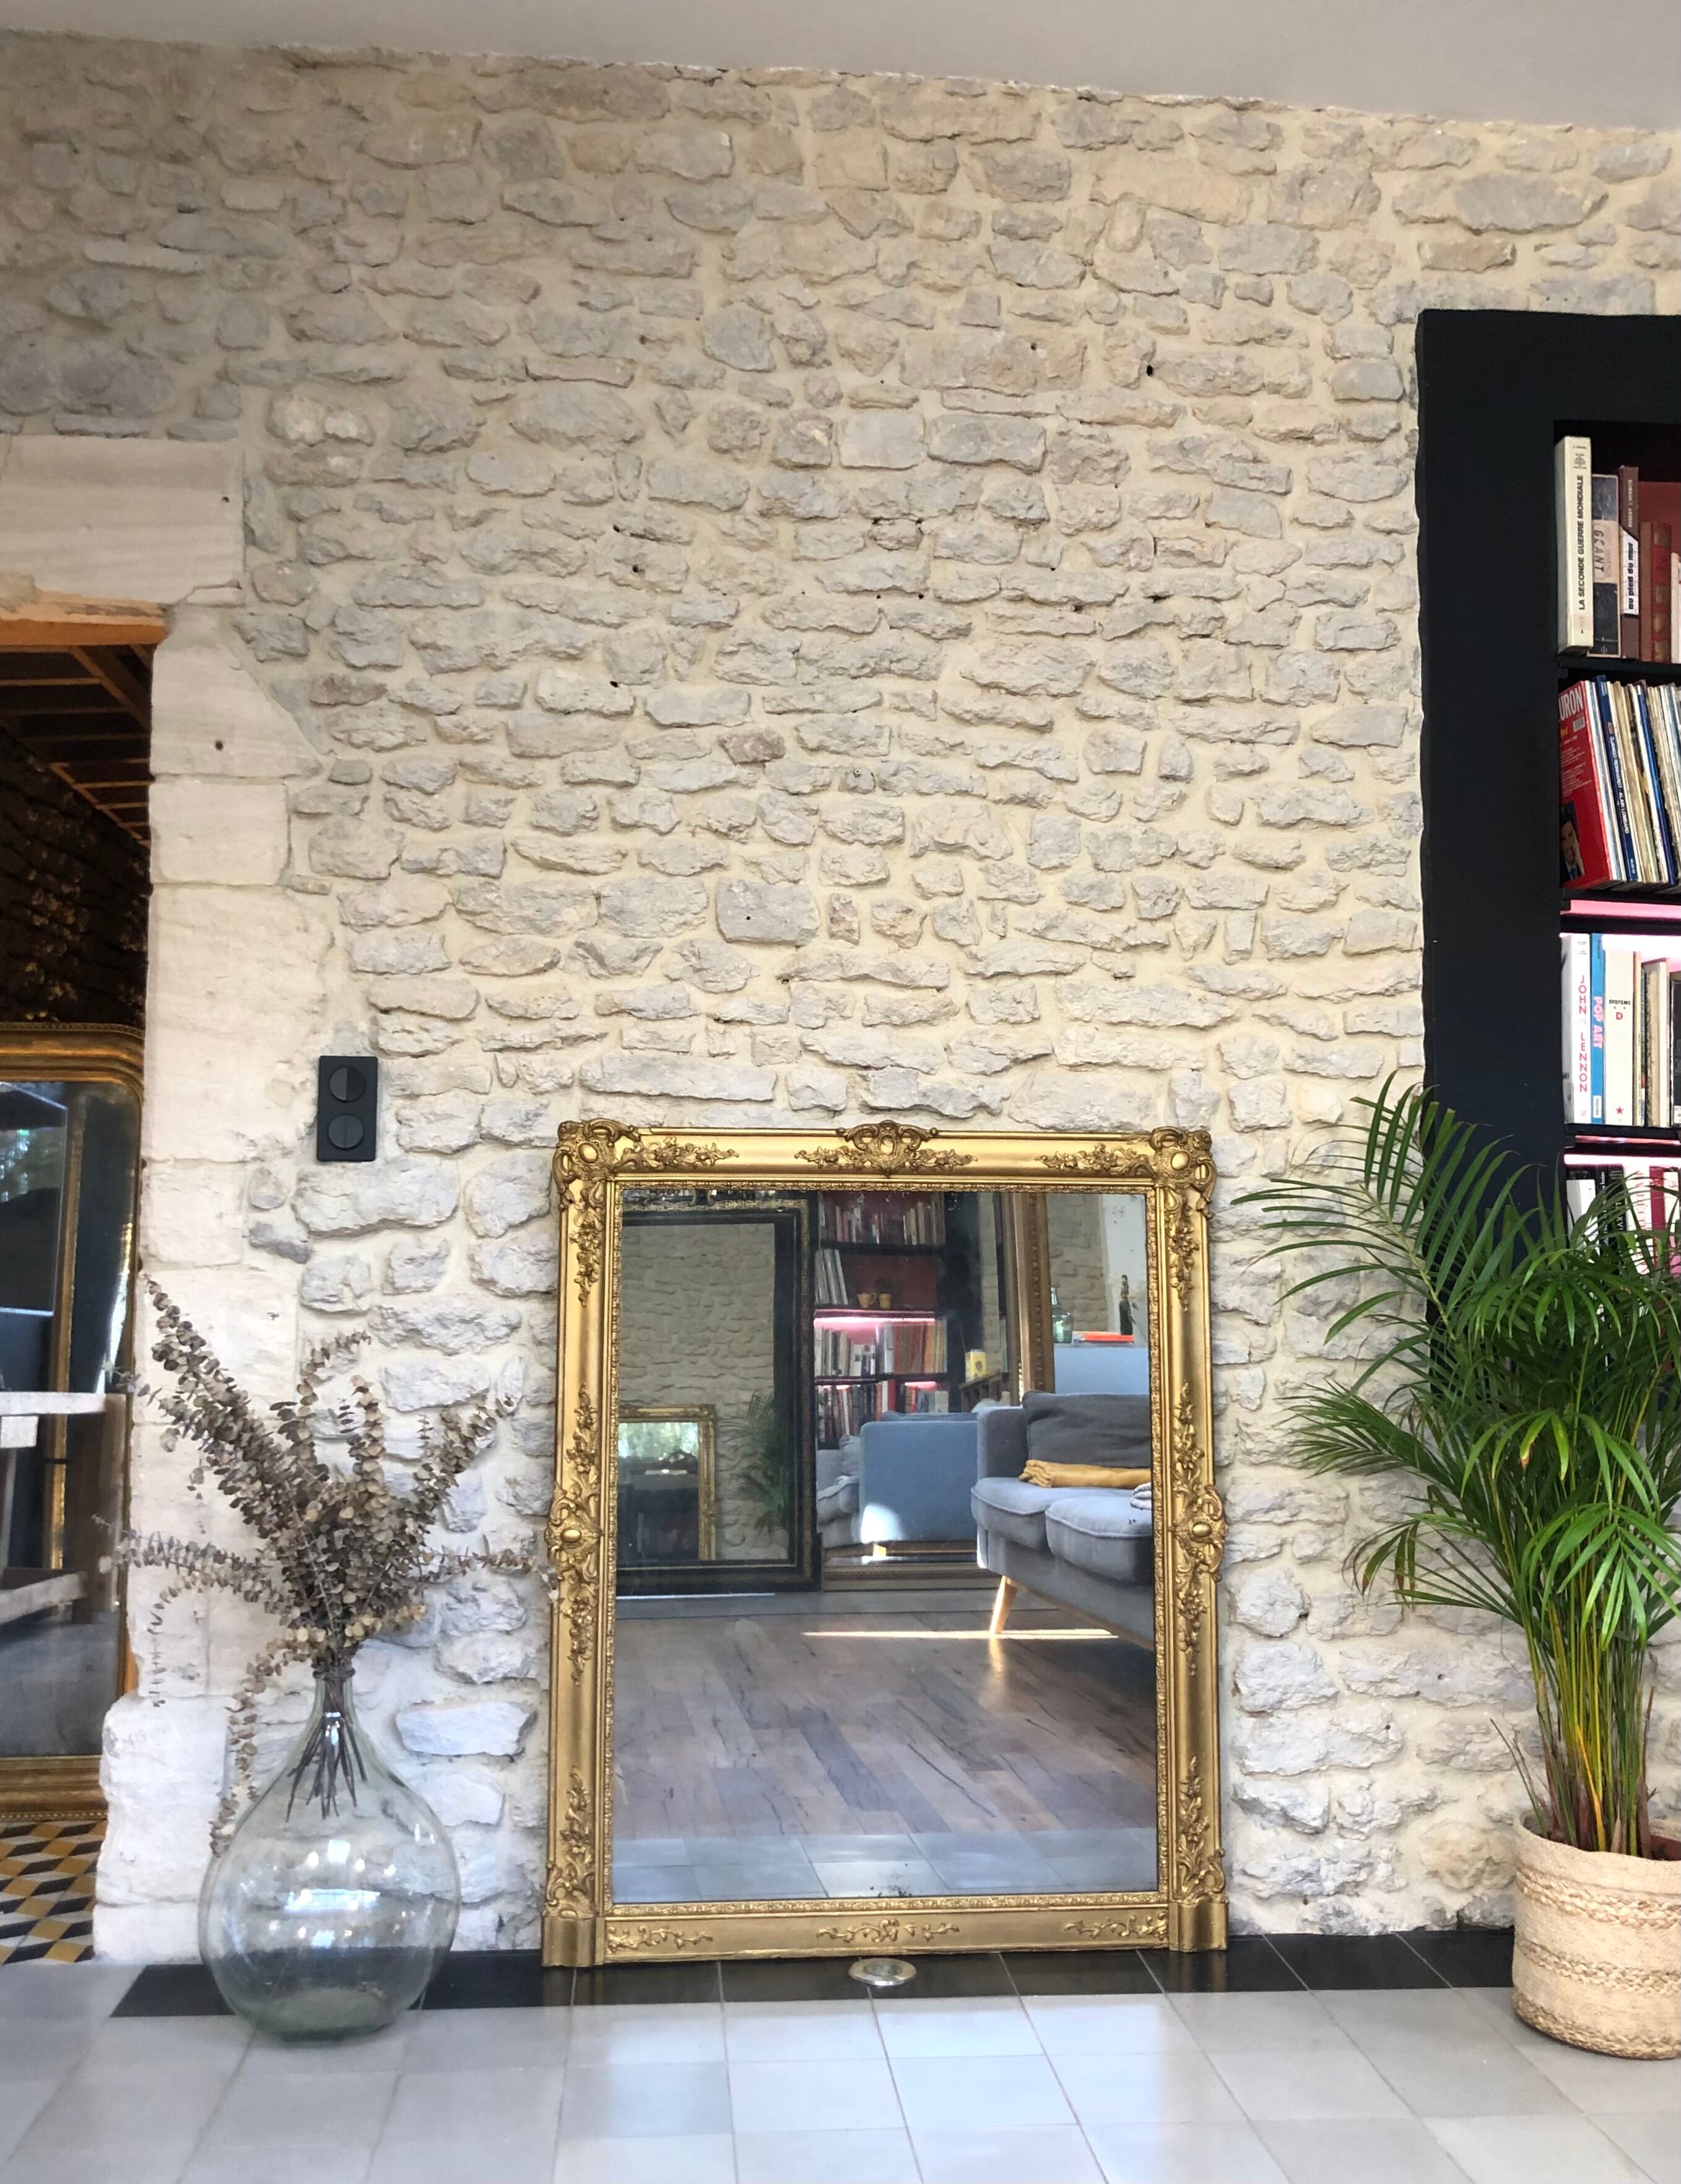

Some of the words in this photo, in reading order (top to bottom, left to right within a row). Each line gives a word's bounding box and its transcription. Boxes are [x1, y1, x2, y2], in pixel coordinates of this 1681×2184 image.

[1627, 563, 1634, 574] du
[1579, 599, 1585, 610] LA
[1558, 685, 1583, 721] URON
[1578, 975, 1587, 1014] JOHN
[1594, 996, 1604, 1022] POP
[1616, 1012, 1623, 1020] D
[1593, 1024, 1603, 1049] ART
[1579, 1032, 1588, 1093] LENNON
